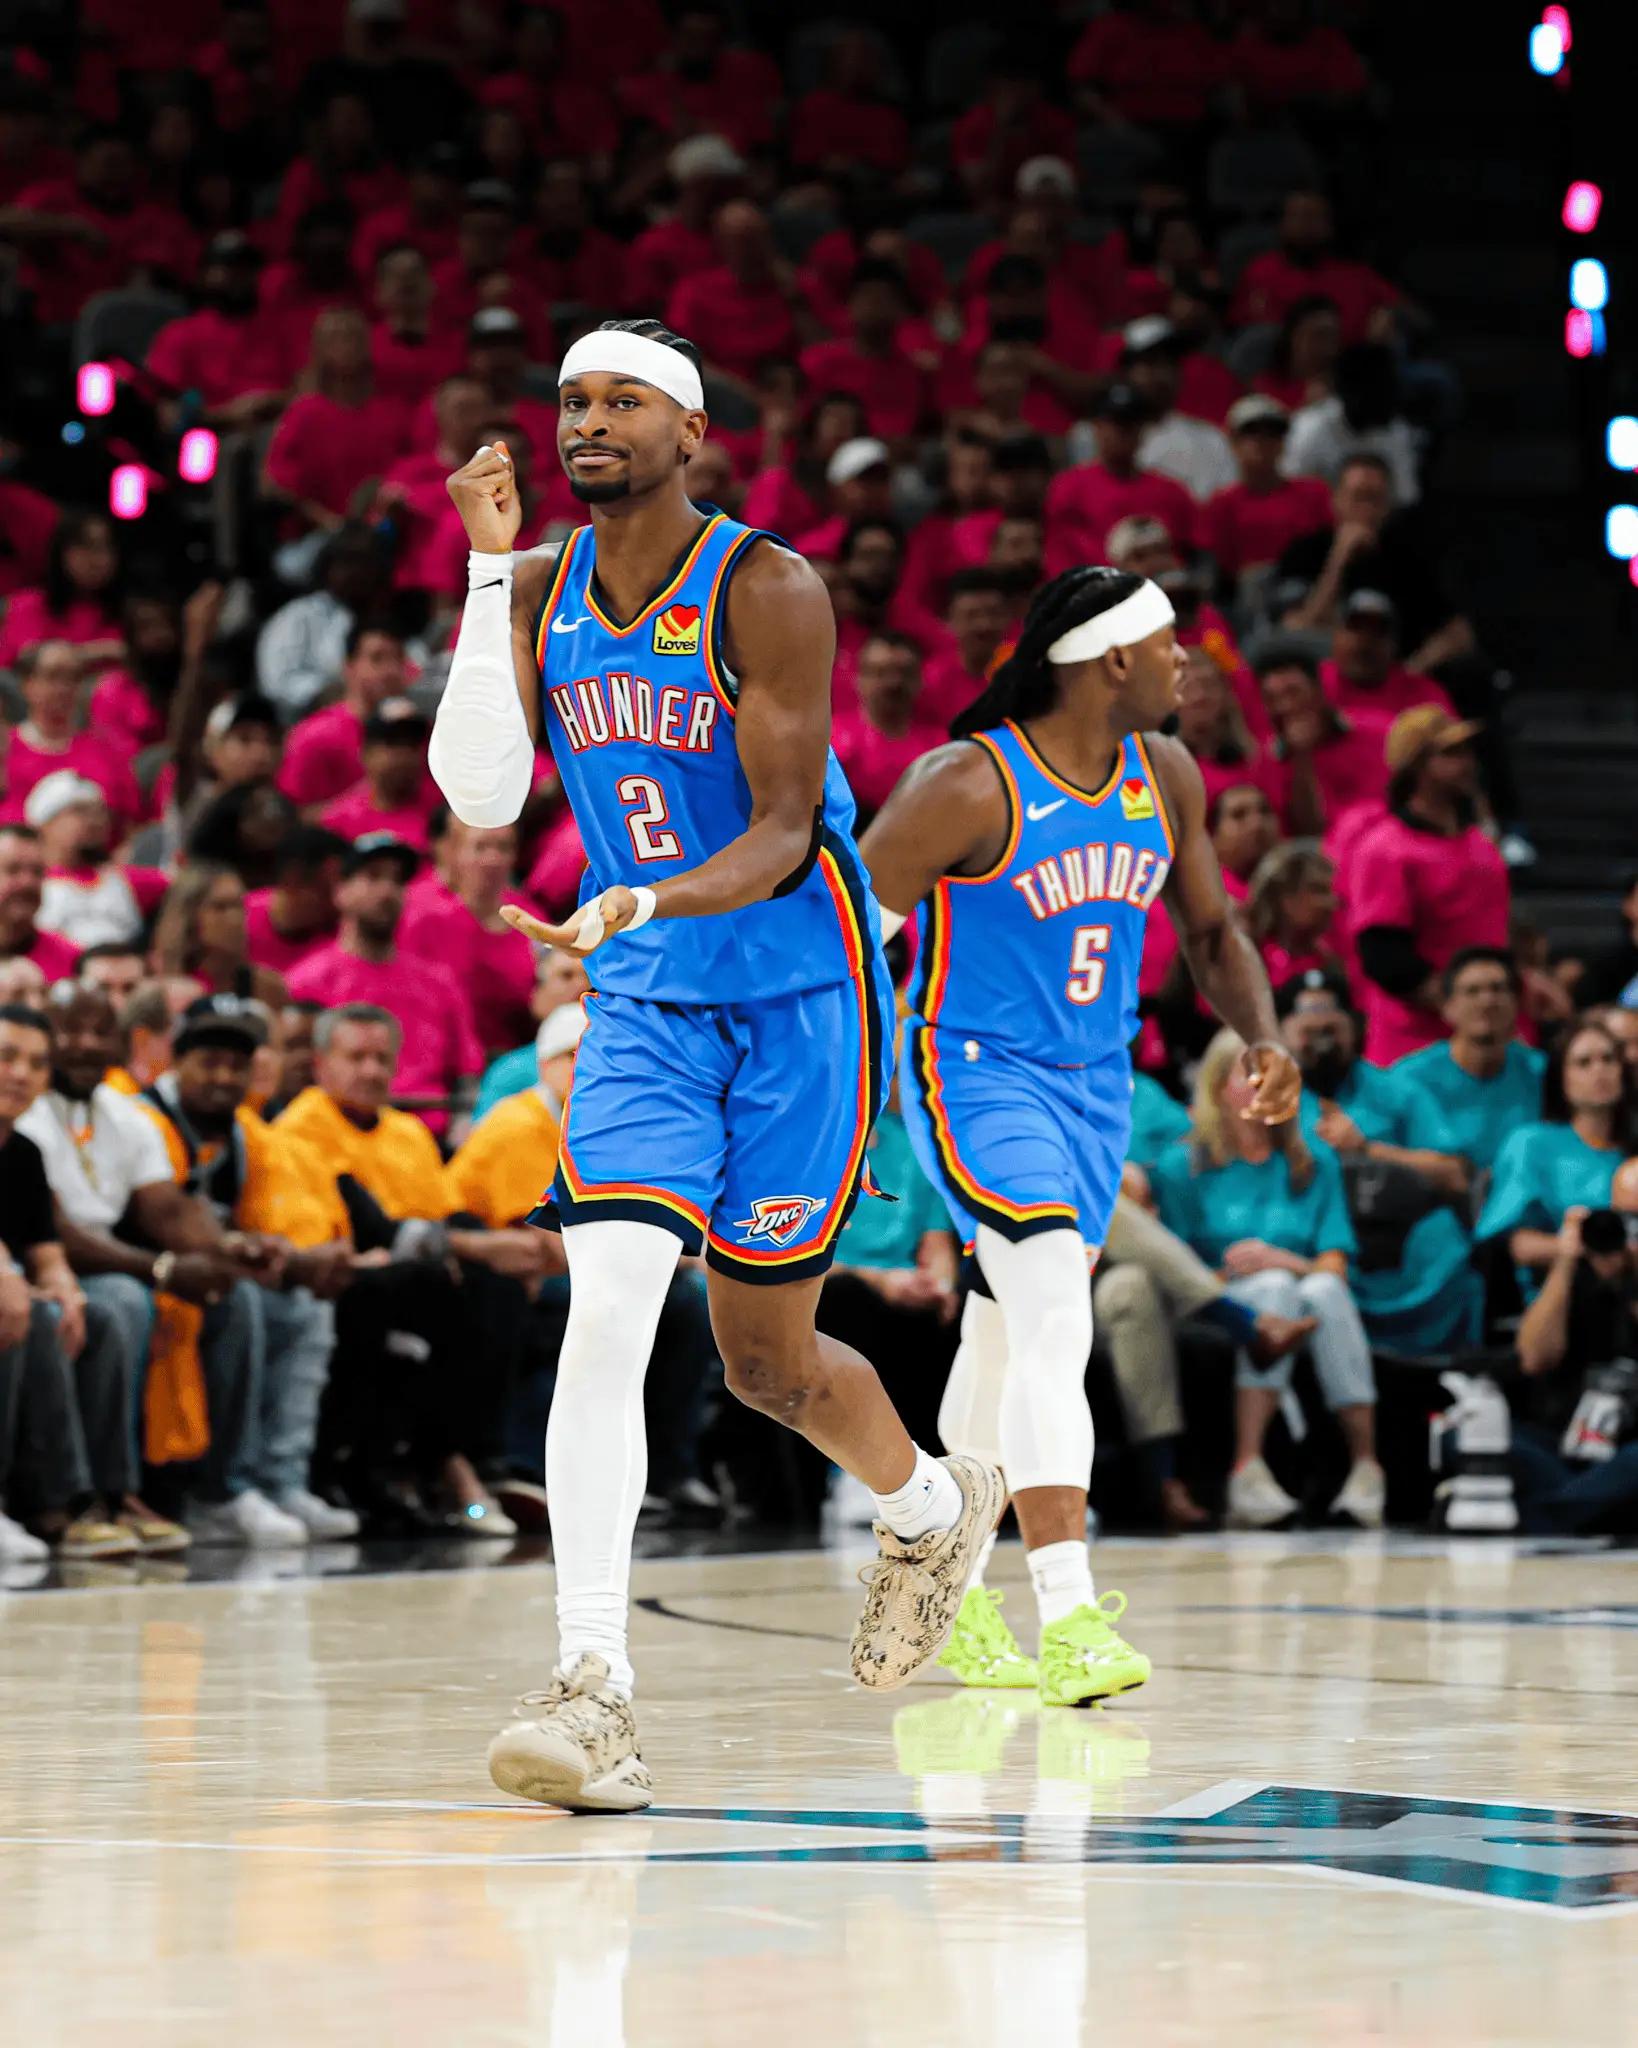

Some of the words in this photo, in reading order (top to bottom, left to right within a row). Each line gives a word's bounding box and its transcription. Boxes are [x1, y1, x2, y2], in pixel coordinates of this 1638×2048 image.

[549, 672, 717, 754] HUNDER
[616, 774, 684, 864] 2
[1065, 924, 1112, 1006] 5
[751, 1204, 802, 1236] OKC
